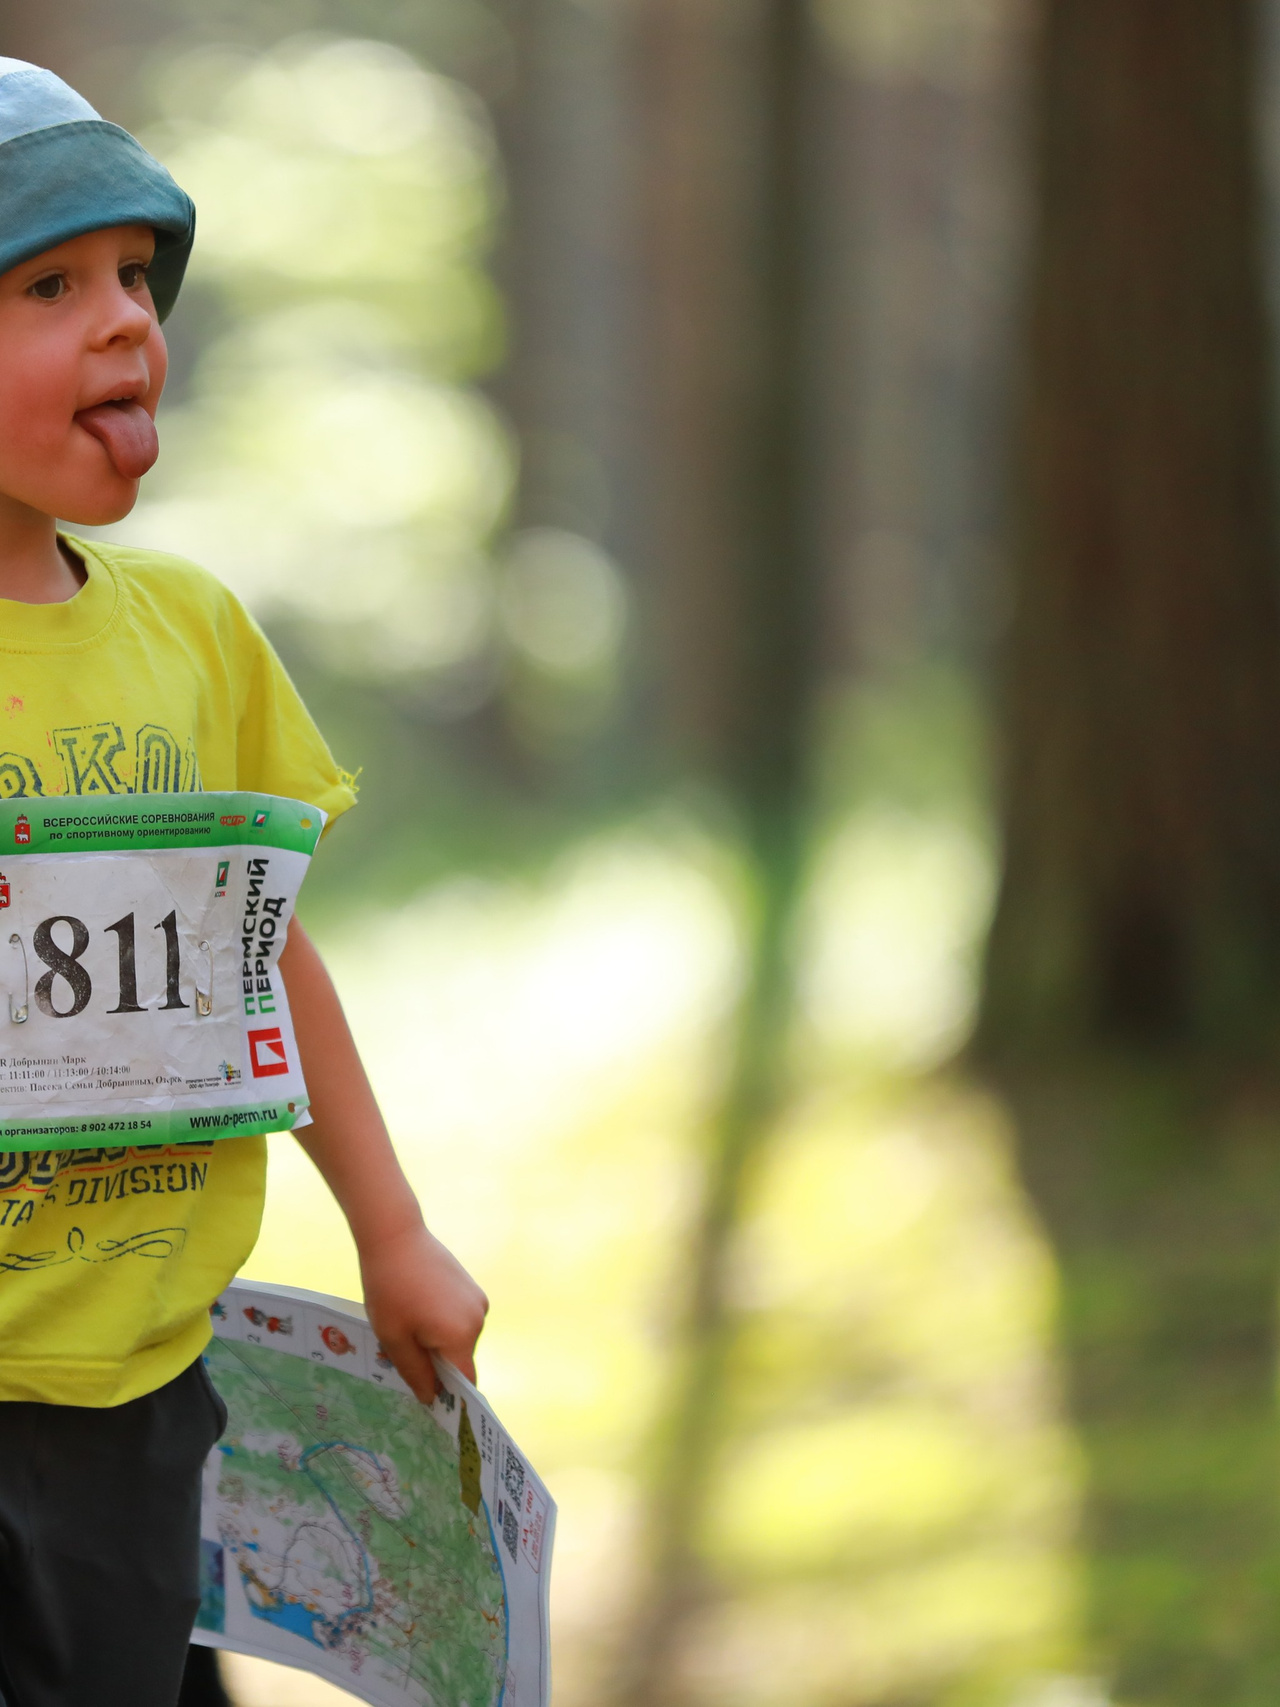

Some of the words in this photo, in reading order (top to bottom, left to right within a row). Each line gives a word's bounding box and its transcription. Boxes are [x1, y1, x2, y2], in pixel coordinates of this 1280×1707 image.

[43, 813, 139, 828] ВСЕРОССИЙСКИЕ
[141, 812, 215, 824] СОРЕВНОВАНИЯ
[49, 832, 63, 841] по
[66, 829, 135, 840] спортивному
[137, 826, 211, 838] ориентированию
[241, 858, 270, 1016] ПЕРМСКИЙ
[33, 909, 190, 1019] 811
[255, 897, 287, 1014] ПЕРИОД
[61, 1055, 87, 1066] Марк
[9, 1069, 45, 1080] 11:11:00
[53, 1067, 89, 1078] 11:13:00
[96, 1065, 131, 1076] 10:14:00
[64, 1081, 93, 1090] Семьи
[189, 1108, 278, 1129] www.o-perm.ru
[4, 1124, 79, 1137] организаторов:
[81, 1123, 87, 1132] 8
[89, 1122, 106, 1132] 902
[108, 1121, 126, 1131] 472
[127, 1120, 139, 1130] 18
[140, 1120, 152, 1129] 54
[65, 1162, 208, 1207] DIVISION
